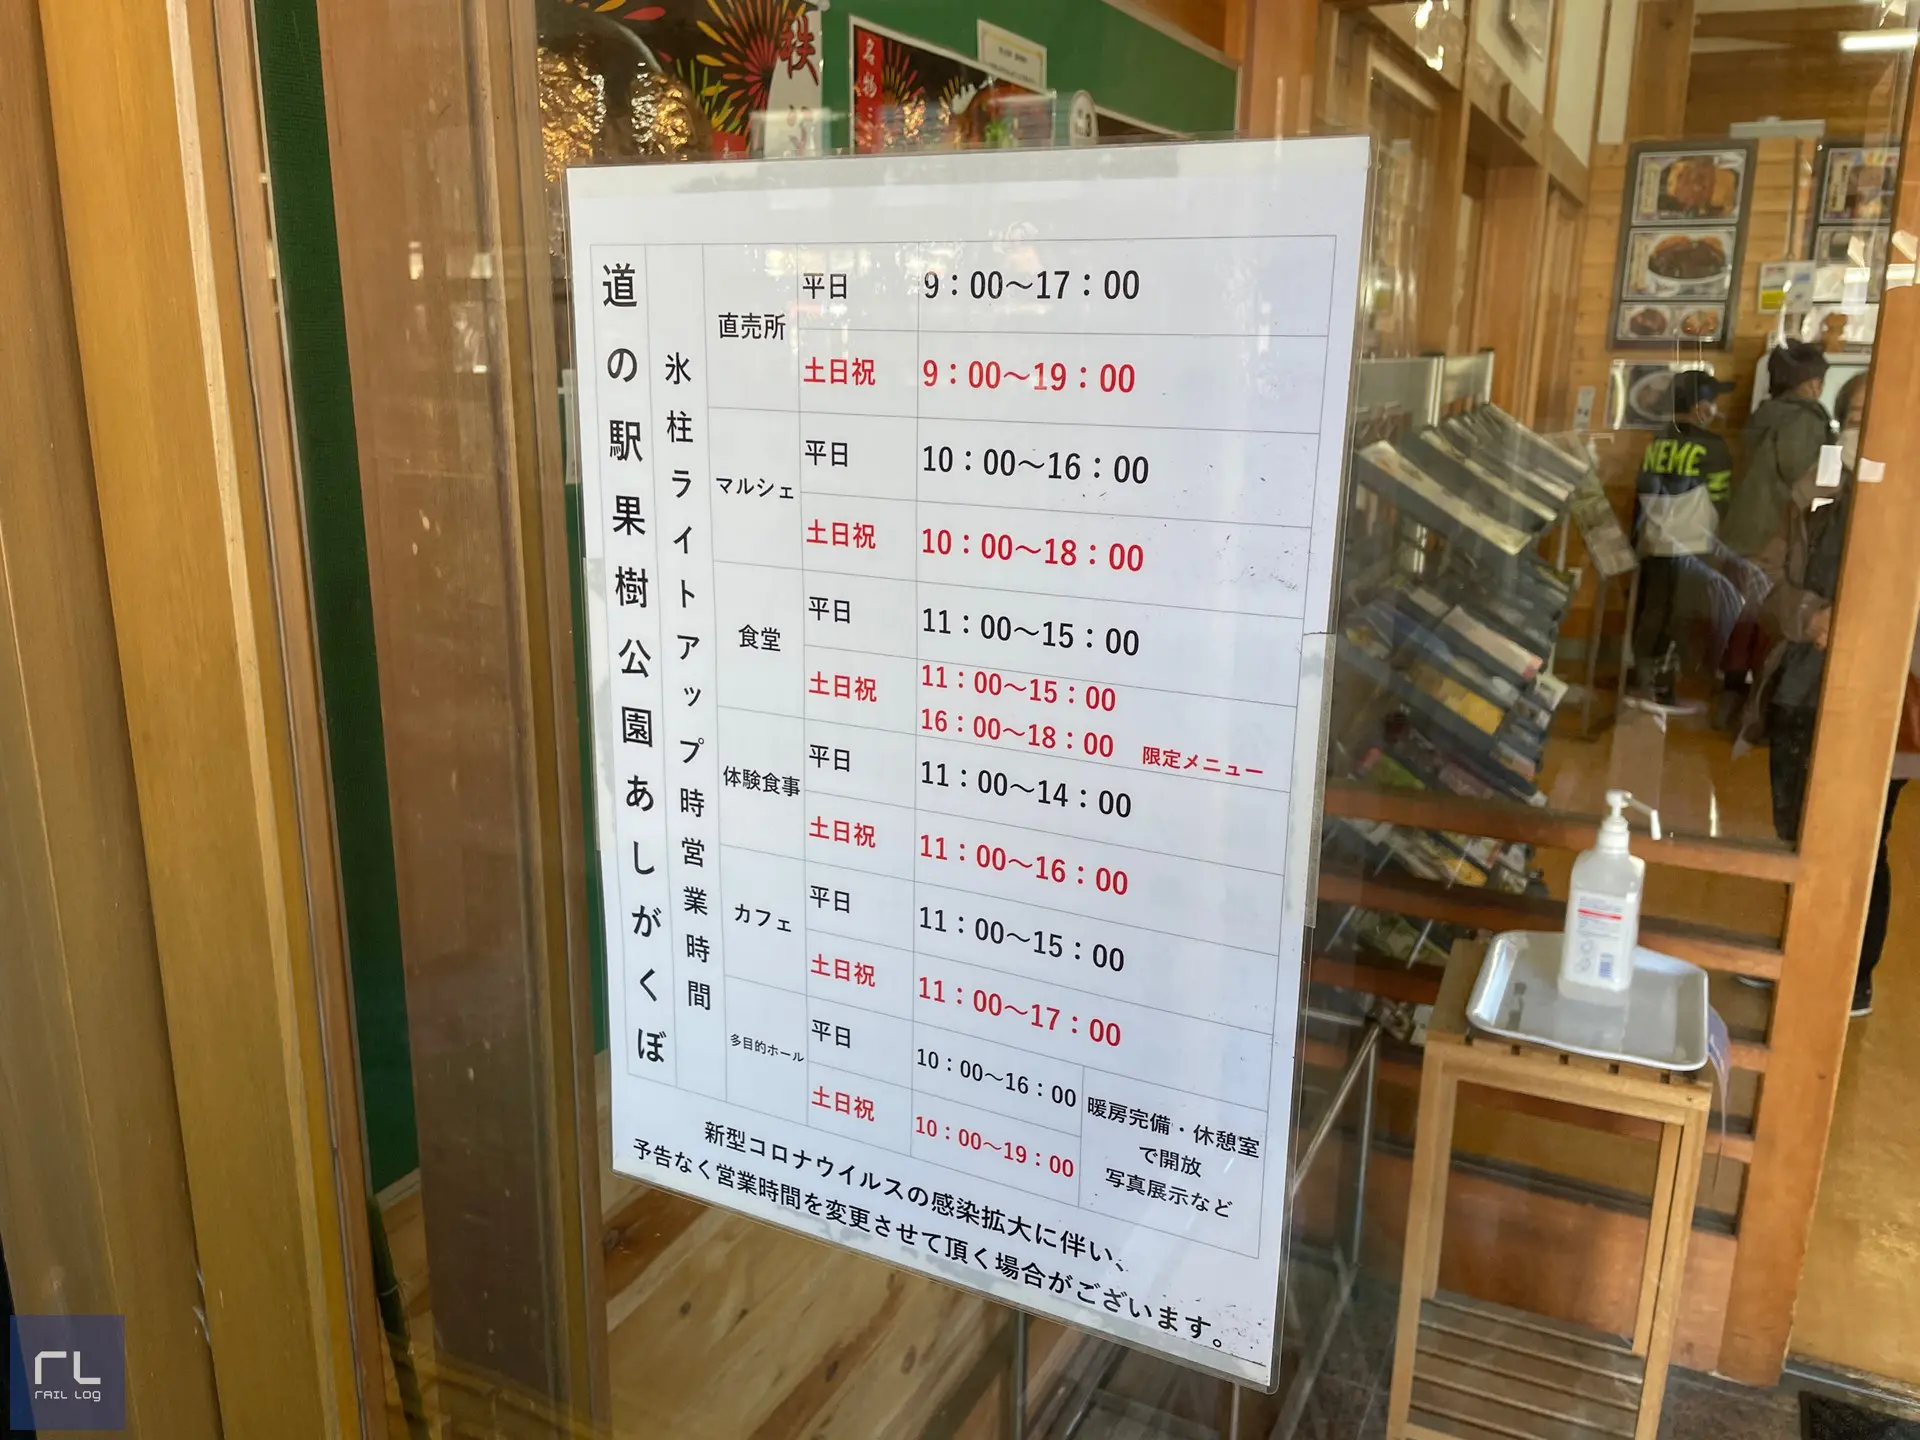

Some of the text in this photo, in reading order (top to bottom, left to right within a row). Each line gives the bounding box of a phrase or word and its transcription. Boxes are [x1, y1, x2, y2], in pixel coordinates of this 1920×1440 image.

[802, 273, 848, 299] 平日
[923, 269, 1140, 299] 9：00～17：00
[718, 313, 786, 340] 直売所
[803, 356, 876, 386] 土日祝
[922, 359, 1136, 393] 9：00～19：00
[805, 440, 849, 467] 平日
[923, 445, 1149, 484] 10：00～16：00
[716, 476, 795, 500] マルシェ
[806, 519, 877, 550] 土日祝
[922, 528, 1144, 572] 10：00～18：00
[808, 597, 850, 624] 平日
[738, 624, 781, 652] 食堂
[922, 608, 1140, 656] 11：00～15：00
[602, 263, 667, 1063] 道の駅果樹公園あしがくぼ
[665, 352, 712, 1011] 氷柱ライトアップ時営業時間
[808, 671, 877, 702] 土日祝
[921, 664, 1116, 712] 11：00～15：00
[808, 744, 850, 772] 平日
[921, 708, 1264, 777] 16：00～18：00 限定メニュー
[723, 765, 801, 797] 体験食事
[921, 761, 1132, 818] 11：00～14：00
[809, 815, 876, 848] 土日祝
[920, 834, 1128, 896] 11：00～16：00
[810, 885, 850, 914] 平日
[734, 903, 792, 933] カフェ
[919, 906, 1125, 972] 11：00～15：00
[811, 953, 876, 987] 土日祝
[919, 976, 1121, 1047] 11：00～17：00
[730, 1033, 804, 1063] 多目的ホール
[811, 1019, 851, 1049] 平日
[917, 1048, 1076, 1107] 10：00～16：00
[811, 1085, 875, 1122] 土日祝
[1087, 1096, 1260, 1159] 暖房完備・休憩室
[915, 1116, 1074, 1178] 10：00～19：00
[1139, 1144, 1202, 1178] で開放
[704, 1120, 1128, 1274] 新型コロナウイルスの感染拡大に伴い、
[1104, 1167, 1233, 1219] 写真展示など
[633, 1138, 1224, 1349] 予告なく営業時間を変更させて頂く場合がございます。
